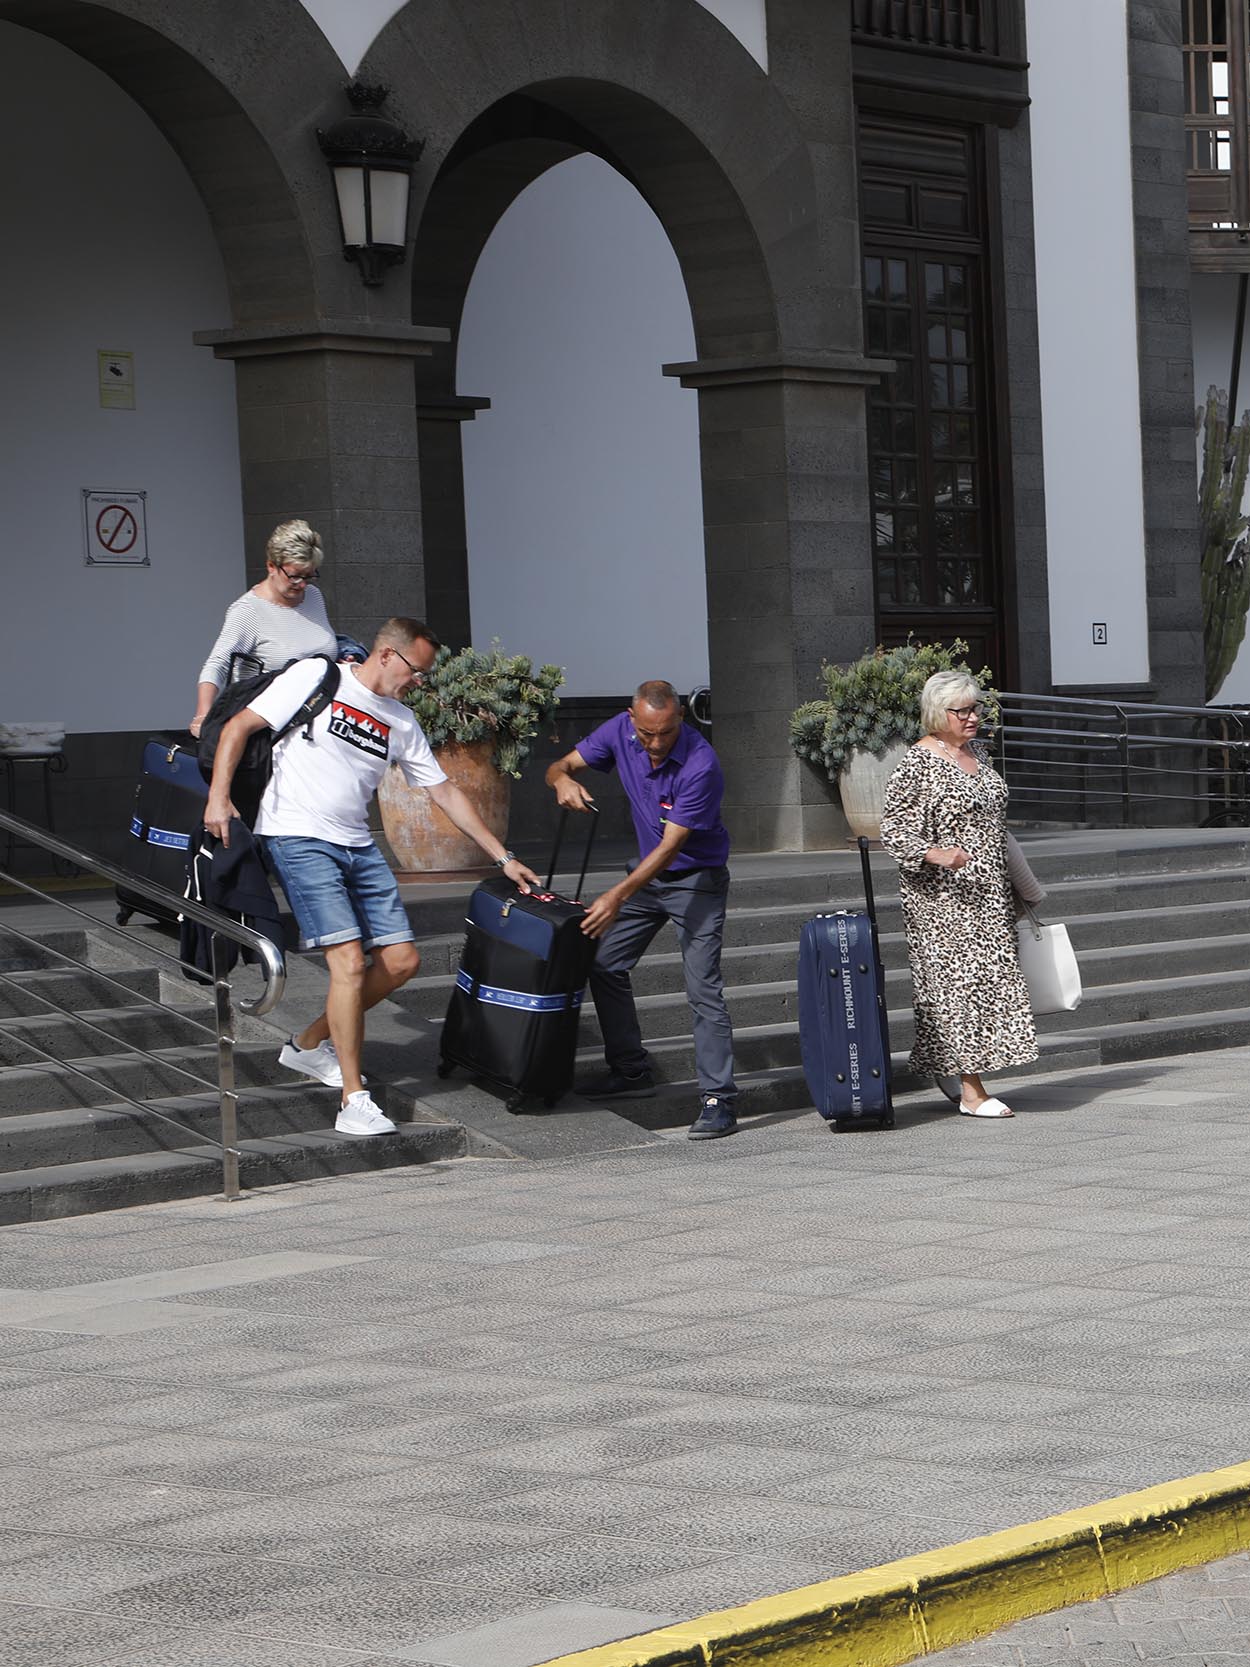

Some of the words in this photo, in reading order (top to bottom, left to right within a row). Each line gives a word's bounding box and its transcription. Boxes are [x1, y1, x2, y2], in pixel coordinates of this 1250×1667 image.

[1097, 628, 1103, 640] 2
[838, 919, 849, 963] E-SERIES
[842, 968, 856, 1029] RICHMOUNT
[849, 1043, 861, 1090] E-SERIES
